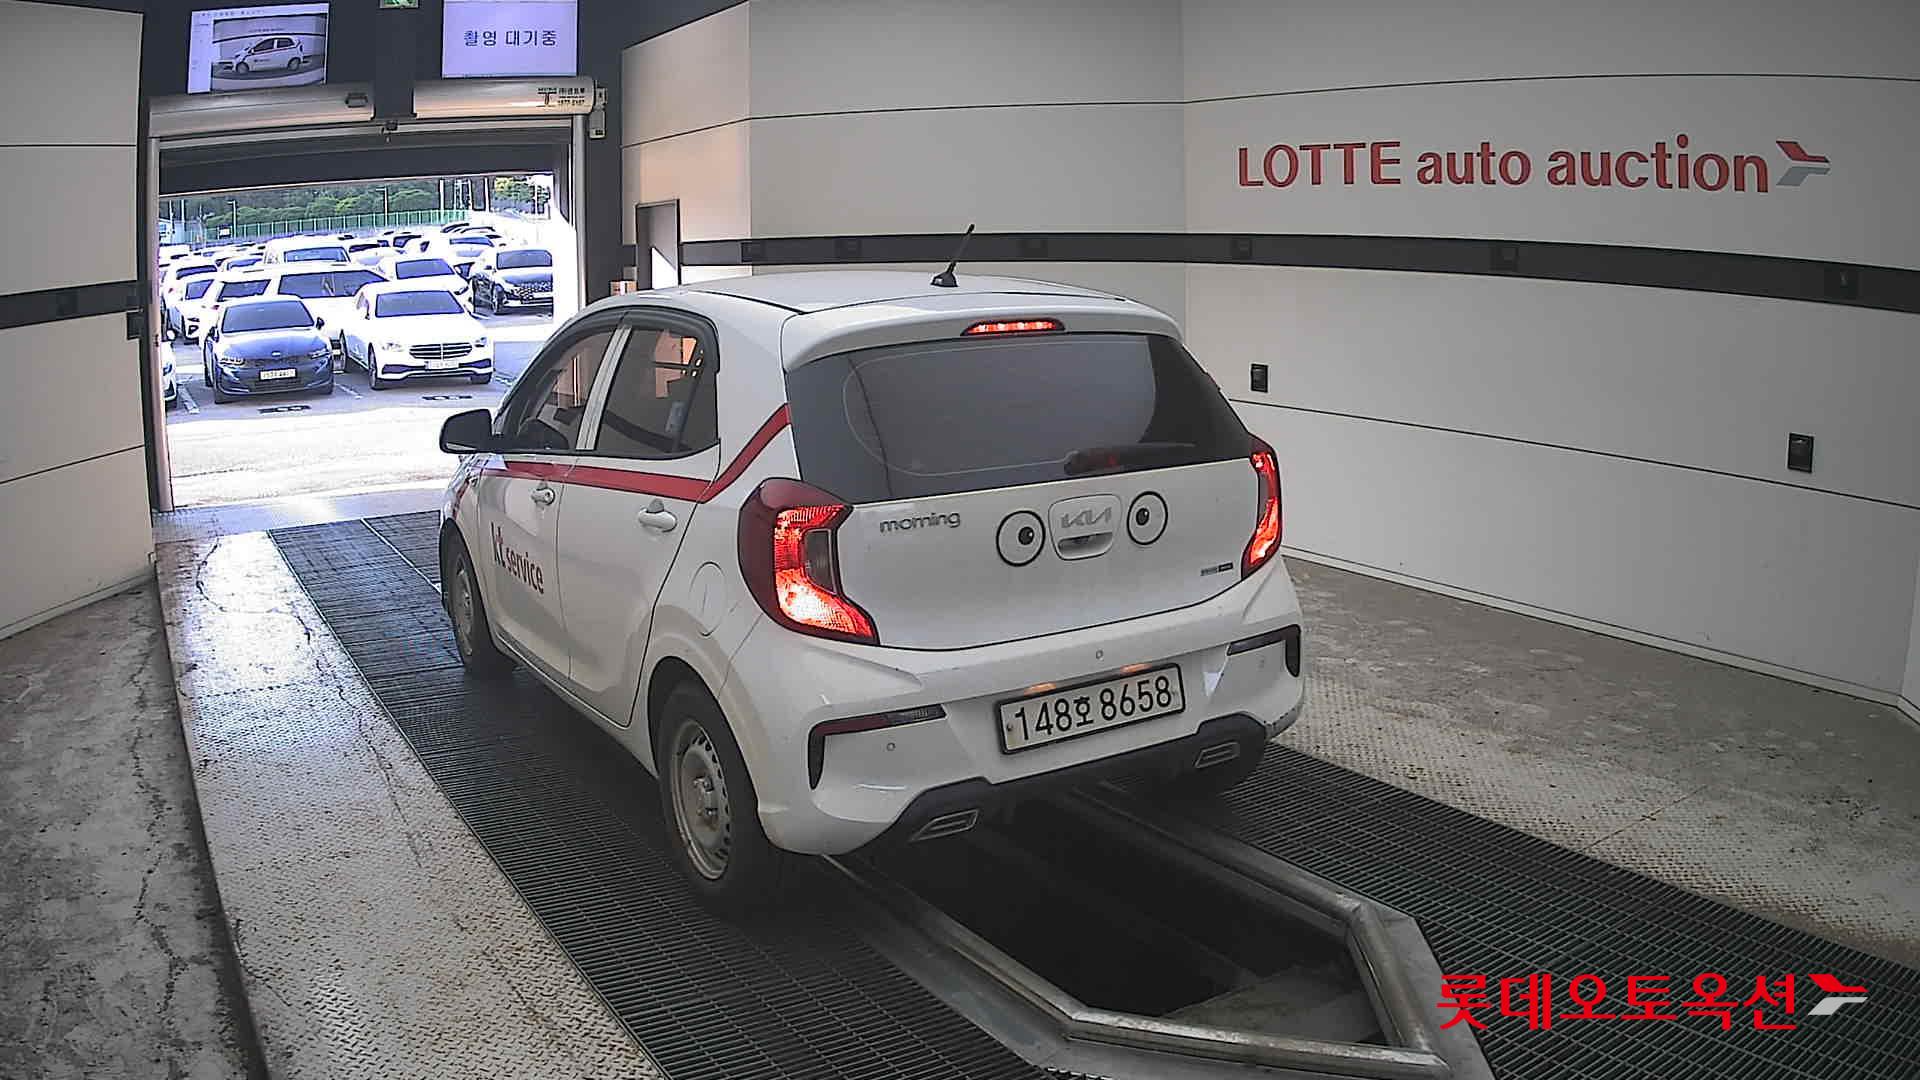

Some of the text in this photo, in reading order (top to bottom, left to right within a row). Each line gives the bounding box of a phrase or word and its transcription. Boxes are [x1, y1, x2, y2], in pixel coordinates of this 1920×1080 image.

[464, 30, 557, 46] 촬영 대기중
[1238, 134, 1769, 193] LOTTE auto auction
[880, 512, 961, 533] morning
[506, 547, 544, 594] service
